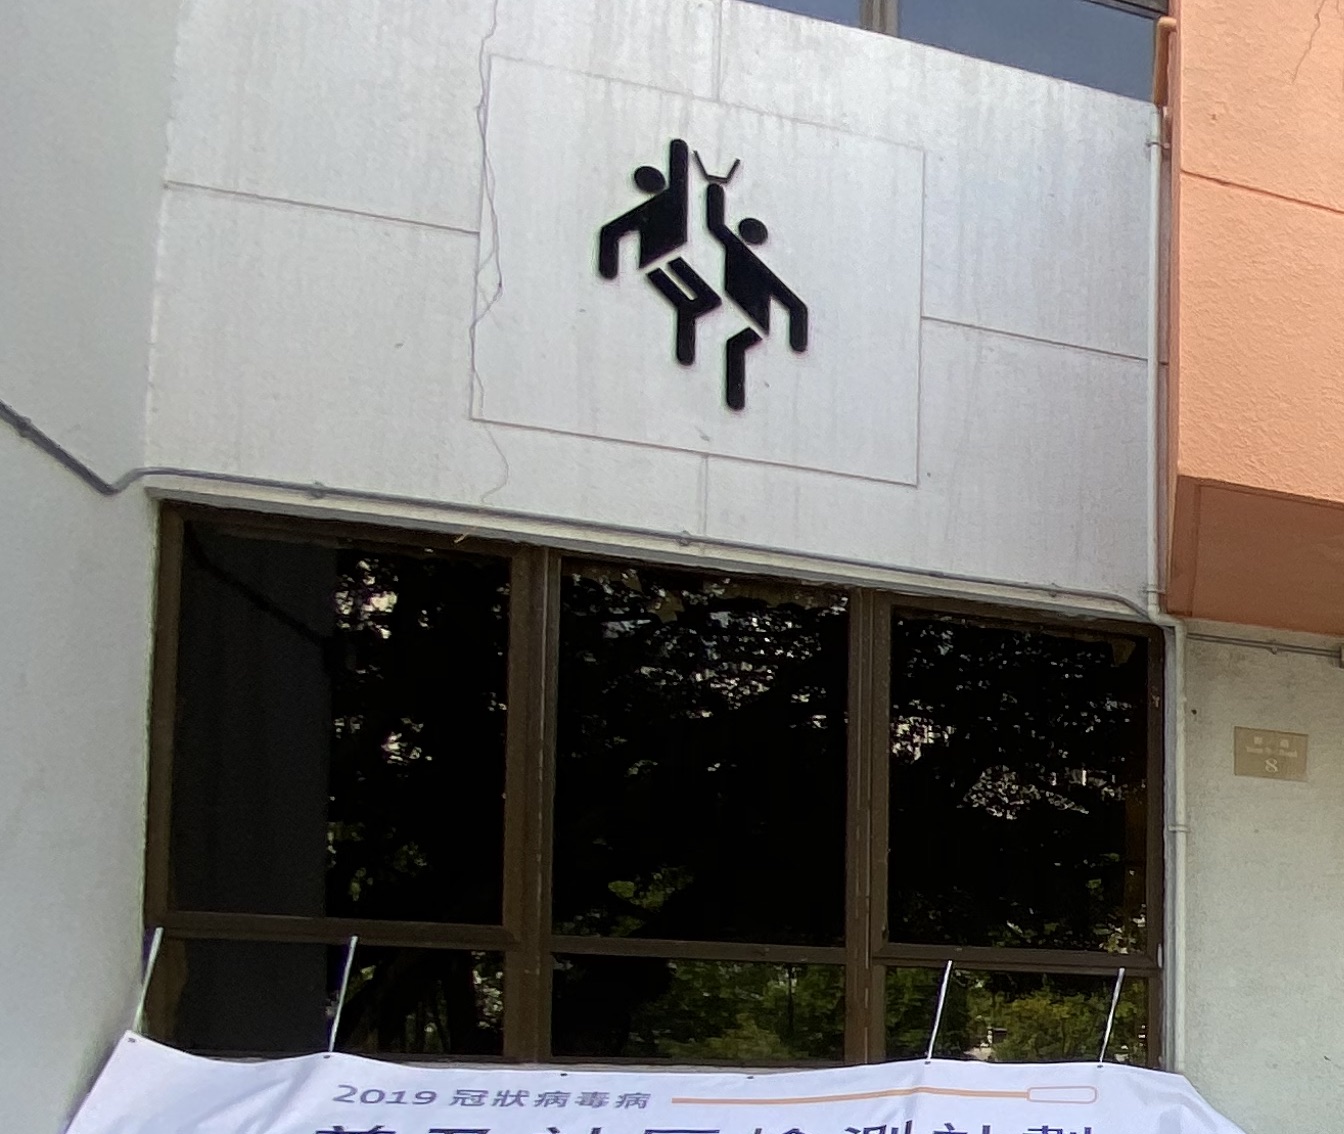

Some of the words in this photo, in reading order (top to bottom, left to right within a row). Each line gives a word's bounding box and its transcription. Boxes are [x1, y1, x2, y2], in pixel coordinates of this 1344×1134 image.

[1265, 758, 1278, 773] 8
[331, 1083, 439, 1108] 2019
[449, 1088, 652, 1111] 冠狀病毒病
